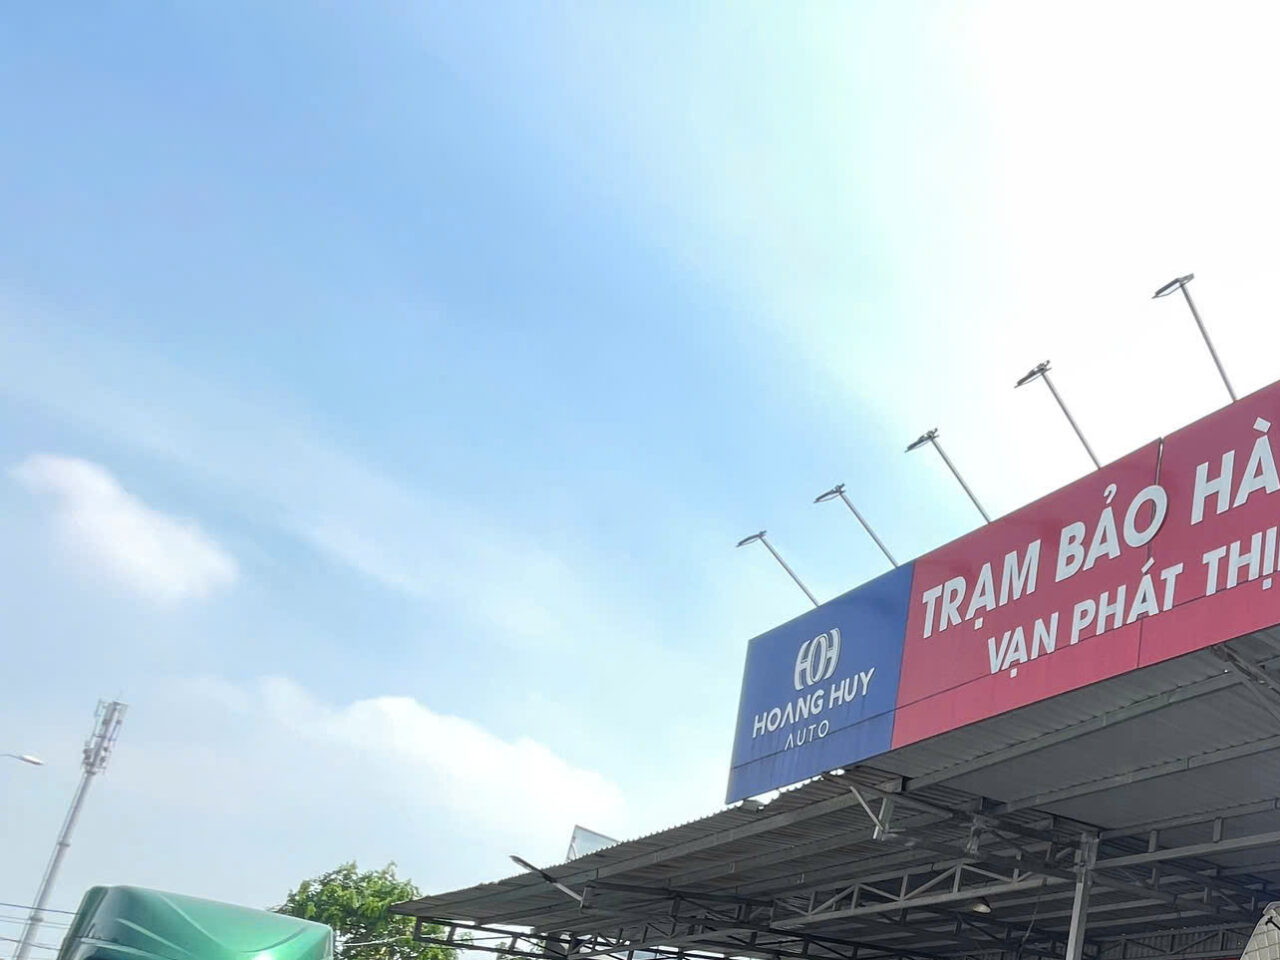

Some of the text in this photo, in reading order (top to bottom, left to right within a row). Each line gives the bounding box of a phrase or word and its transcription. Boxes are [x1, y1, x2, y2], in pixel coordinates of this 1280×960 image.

[921, 539, 1042, 638] TRẠM
[1054, 483, 1168, 583] BẢO
[986, 612, 1060, 678] VẠN
[1069, 558, 1184, 645] PHÁT
[752, 667, 876, 739] HOANG HUY
[784, 720, 829, 751] AUTO
